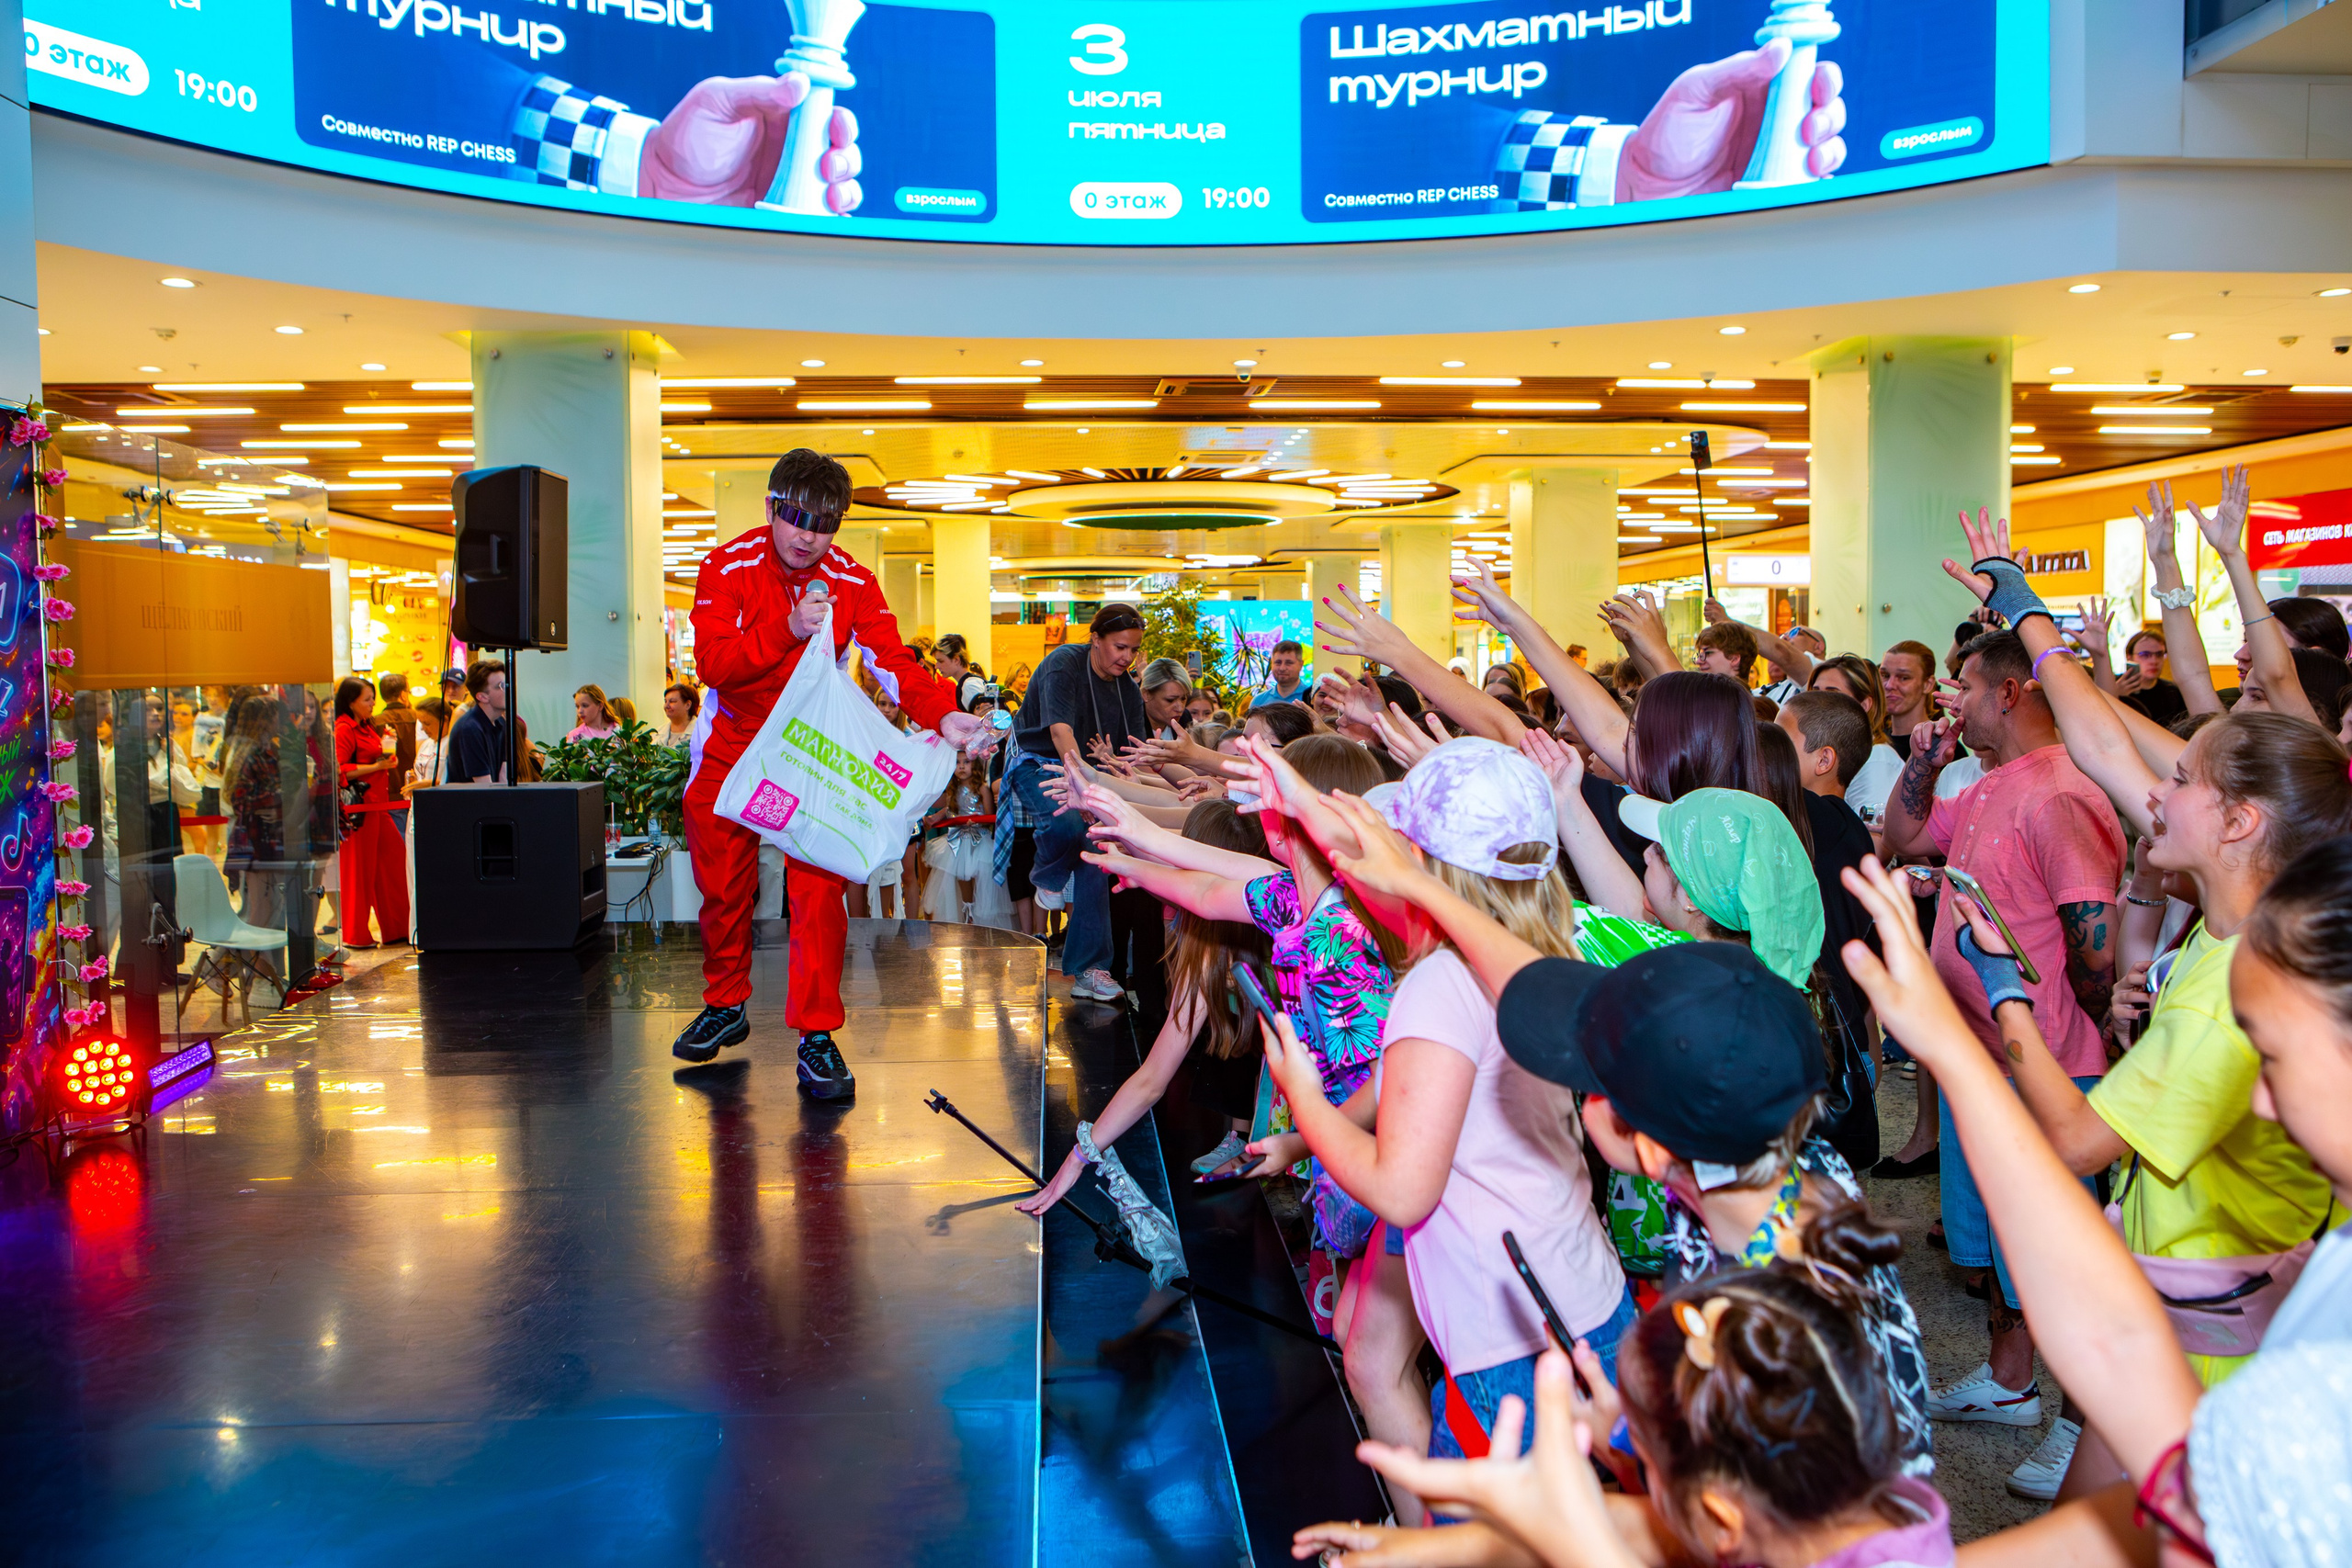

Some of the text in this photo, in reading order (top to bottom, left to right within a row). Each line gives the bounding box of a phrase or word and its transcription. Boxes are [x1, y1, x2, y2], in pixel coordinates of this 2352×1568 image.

[1329, 0, 1692, 59] Шахматный
[1069, 24, 1129, 75] 3
[49, 44, 131, 83] этаж
[175, 68, 258, 113] 19:00
[1329, 61, 1548, 108] турнир
[1068, 90, 1162, 108] июля
[322, 114, 518, 164] Совместно REP CHESS
[1068, 121, 1227, 144] пятница
[1893, 125, 1973, 150] взрослым
[905, 193, 977, 208] взрослым
[1084, 192, 1167, 209] 0 этаж
[1202, 186, 1271, 209] 19:00
[1324, 184, 1499, 209] Совместно REP CHESS
[2263, 530, 2286, 547] СЕТЬ
[2285, 524, 2344, 545] МАГАЗИНОВ
[788, 724, 897, 804] МАГНОЛИЯ
[878, 756, 908, 782] 24/7
[1717, 815, 1742, 844] Адлер
